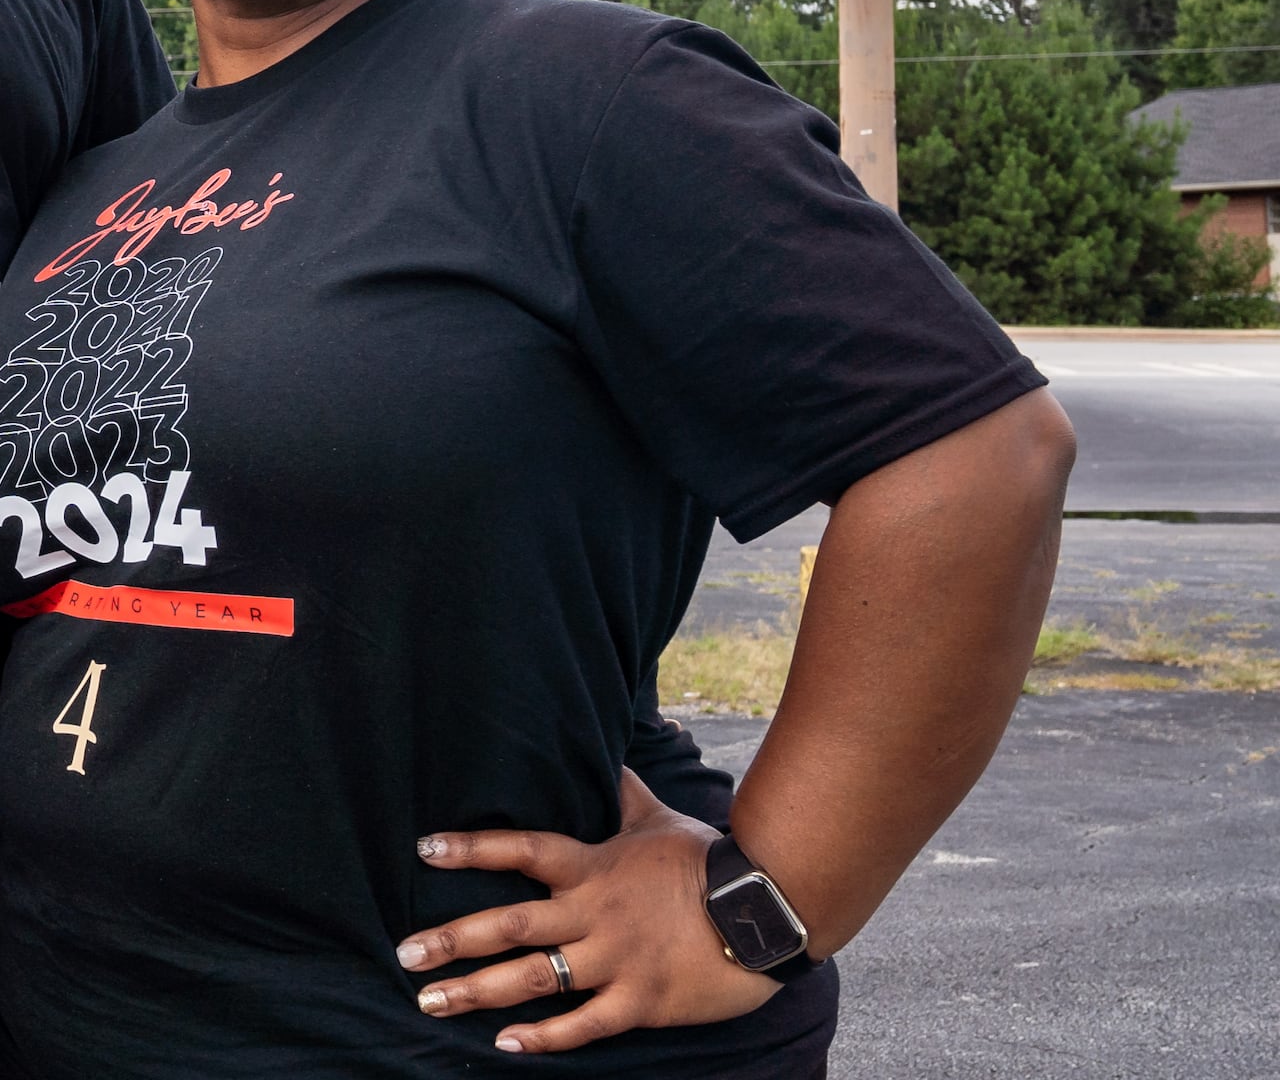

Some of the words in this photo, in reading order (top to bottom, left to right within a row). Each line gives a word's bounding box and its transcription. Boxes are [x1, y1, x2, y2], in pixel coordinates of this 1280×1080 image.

[44, 246, 224, 307] 2020
[7, 280, 212, 365] 2021
[169, 600, 263, 622] YEAR
[53, 659, 108, 776] 4
